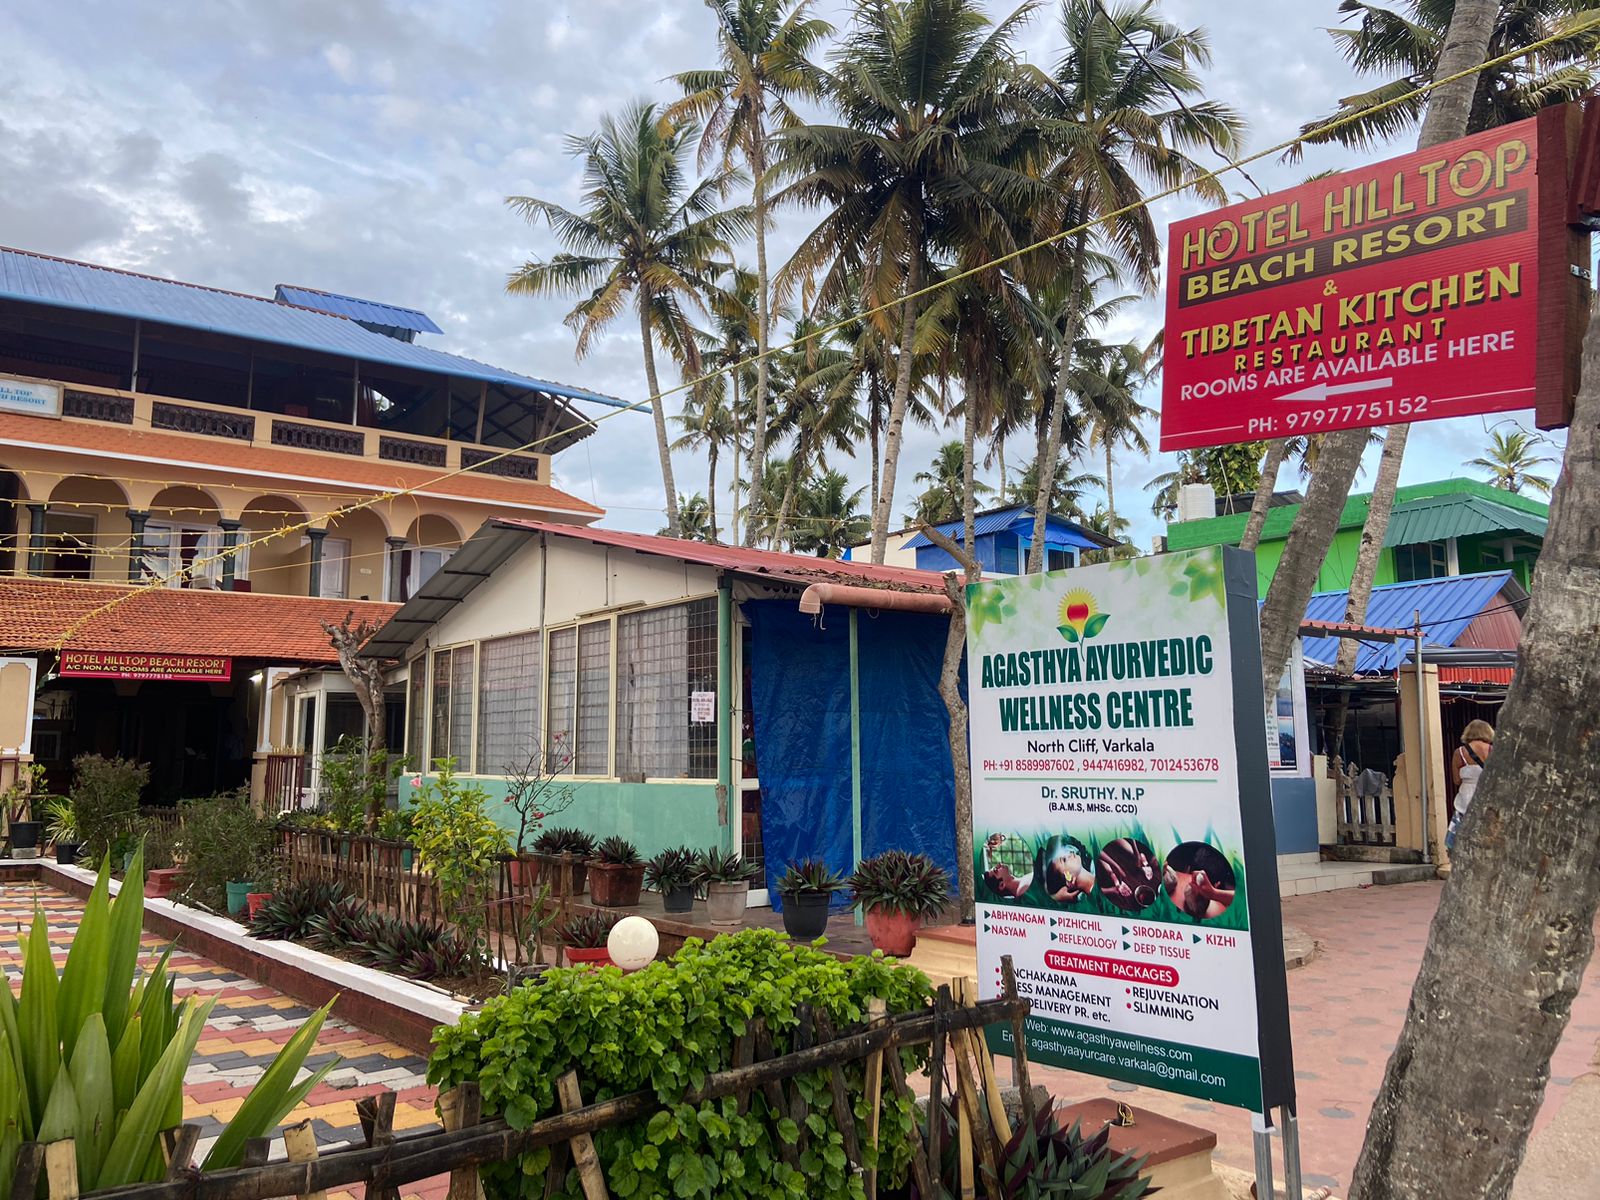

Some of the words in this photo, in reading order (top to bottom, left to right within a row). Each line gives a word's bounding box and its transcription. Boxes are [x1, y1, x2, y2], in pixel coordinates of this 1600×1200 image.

[1182, 204, 1308, 269] HOTEL
[1324, 138, 1528, 232] HILLTOP
[1187, 248, 1315, 301] BEACH
[1333, 198, 1516, 265] RESORT
[1323, 279, 1338, 296] &
[1180, 302, 1322, 358] TIBETAN
[1338, 262, 1521, 327] KITCHEN
[1234, 317, 1447, 372] RESTAURANT
[1180, 374, 1258, 401] ROOMS
[1264, 365, 1305, 388] ARE
[1312, 341, 1438, 381] AVAILABLE
[1448, 330, 1515, 360] HERE
[1248, 414, 1278, 434] PH:
[1285, 395, 1428, 430] 9797775152
[66, 654, 100, 664] HOTEL
[103, 655, 147, 666] HILLTOP
[149, 657, 184, 667] BEACH
[186, 658, 226, 668] RESORT
[981, 647, 1082, 688] AGASTHYA
[1086, 634, 1214, 681] AYURVEDIC
[999, 693, 1101, 732] WELLNESS
[1107, 688, 1194, 729] CENTRE
[1027, 740, 1065, 754] North
[1068, 739, 1099, 755] Cliff,
[1102, 737, 1155, 752] Varkala
[983, 759, 998, 771] PH:
[999, 760, 1013, 771] +91
[1083, 759, 1147, 772] 9447416982,
[1150, 758, 1219, 771] 7012453678
[1041, 786, 1058, 799] Dr.
[1061, 786, 1118, 799] SRUTHY.
[1121, 787, 1145, 800] N.P
[1115, 804, 1137, 815] CCD)
[991, 910, 1046, 925] ABHYANGAM
[1058, 917, 1102, 932] PIZHICHIL
[991, 925, 1027, 938] NASYAM
[1059, 932, 1117, 950] REFLEXOLOGY
[1132, 925, 1183, 941] SIRODARA
[1206, 934, 1236, 948] KIZHI
[1134, 942, 1156, 955] DEEP
[1159, 945, 1191, 959] TISSUE
[1001, 966, 1077, 987] NCHAKARMA
[1048, 953, 1110, 973] TREATMENT
[1112, 964, 1173, 983] PACKAGES
[1035, 984, 1111, 1007] MANAGEMENT
[1132, 986, 1219, 1010] REJUVENATION
[1075, 1006, 1089, 1018] PR.
[1092, 1011, 1111, 1022] etc.
[1133, 1001, 1194, 1021] SLIMMING
[1025, 1018, 1049, 1033] Web:
[1051, 1025, 1193, 1061] www.agasthyawellness.com
[1031, 1037, 1226, 1087] agasthyaayurcare.varkala@gmail.com
